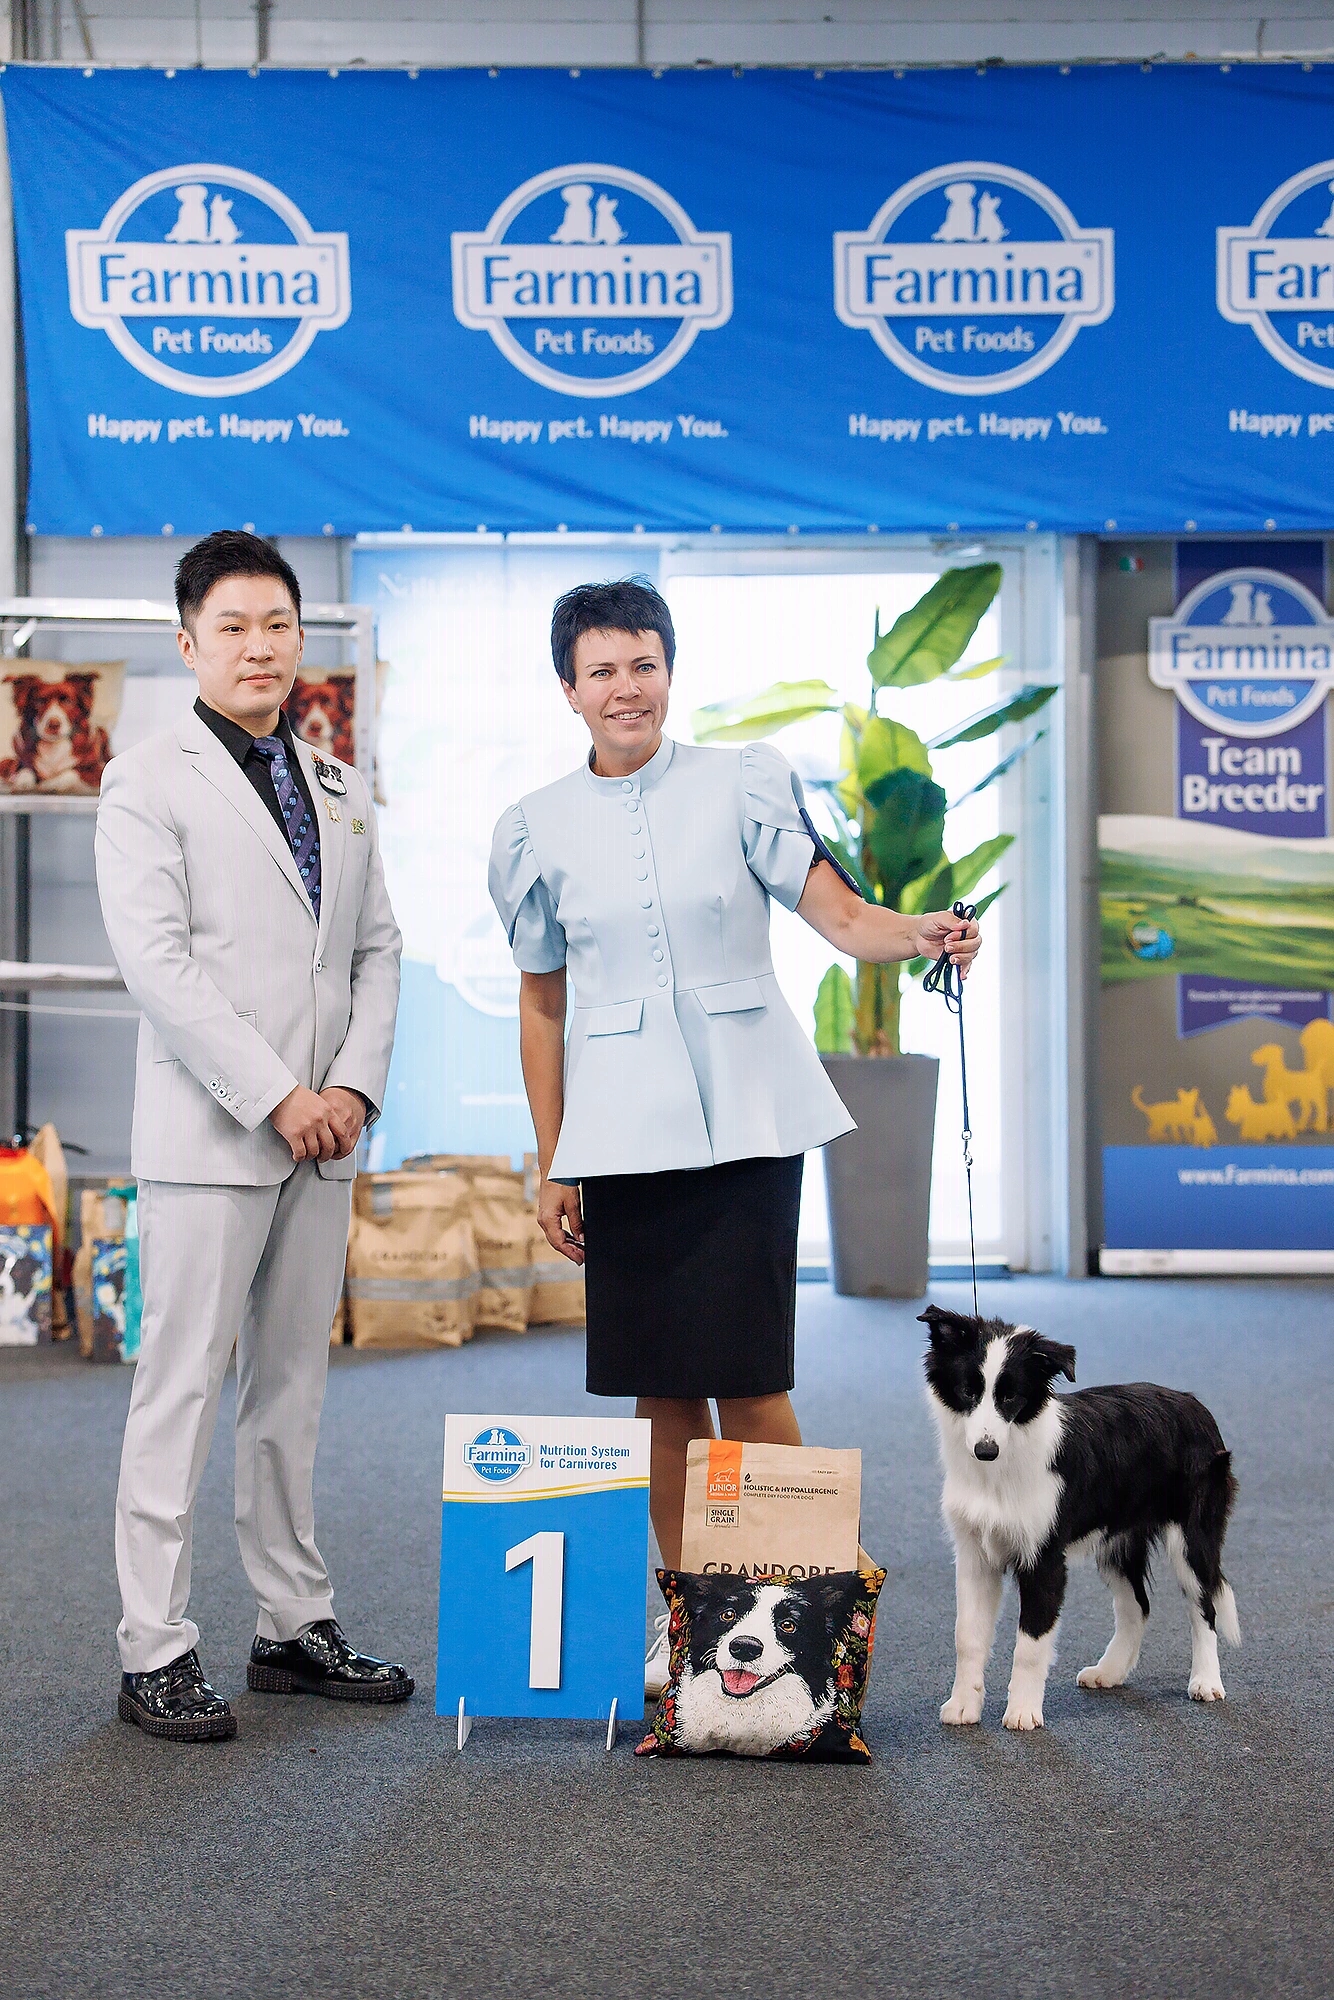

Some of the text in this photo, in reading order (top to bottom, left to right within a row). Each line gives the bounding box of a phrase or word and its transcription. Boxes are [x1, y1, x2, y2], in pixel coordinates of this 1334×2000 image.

[99, 254, 319, 305] Farmina
[483, 255, 703, 306] Farmina
[866, 253, 1084, 304] Farmina
[153, 326, 274, 354] Pet Foods
[535, 328, 655, 355] Pet Foods
[915, 326, 1035, 352] Pet Foods
[1297, 321, 1334, 349] Pet
[87, 412, 349, 444] Happy pet. Happy You.
[469, 413, 729, 444] Happy pet. Happy You.
[849, 411, 1108, 443] Happy pet. Happy You.
[1229, 409, 1303, 438] Happy
[1171, 632, 1331, 670] Farmina
[1207, 684, 1297, 708] Pet Foods
[1201, 737, 1301, 776] Team
[1182, 773, 1325, 814] Breeder
[468, 1446, 526, 1462] Farmina
[540, 1444, 630, 1459] Nutrition System
[540, 1458, 618, 1470] for Carnivores
[481, 1466, 512, 1475] Pet Foods
[708, 1484, 738, 1493] JUNIOR
[743, 1484, 774, 1492] HOLISTIC
[781, 1486, 839, 1495] HYPOALLERGENIC
[710, 1516, 735, 1524] GRAIN
[711, 1509, 735, 1517] SINGLE
[505, 1531, 565, 1689] 1
